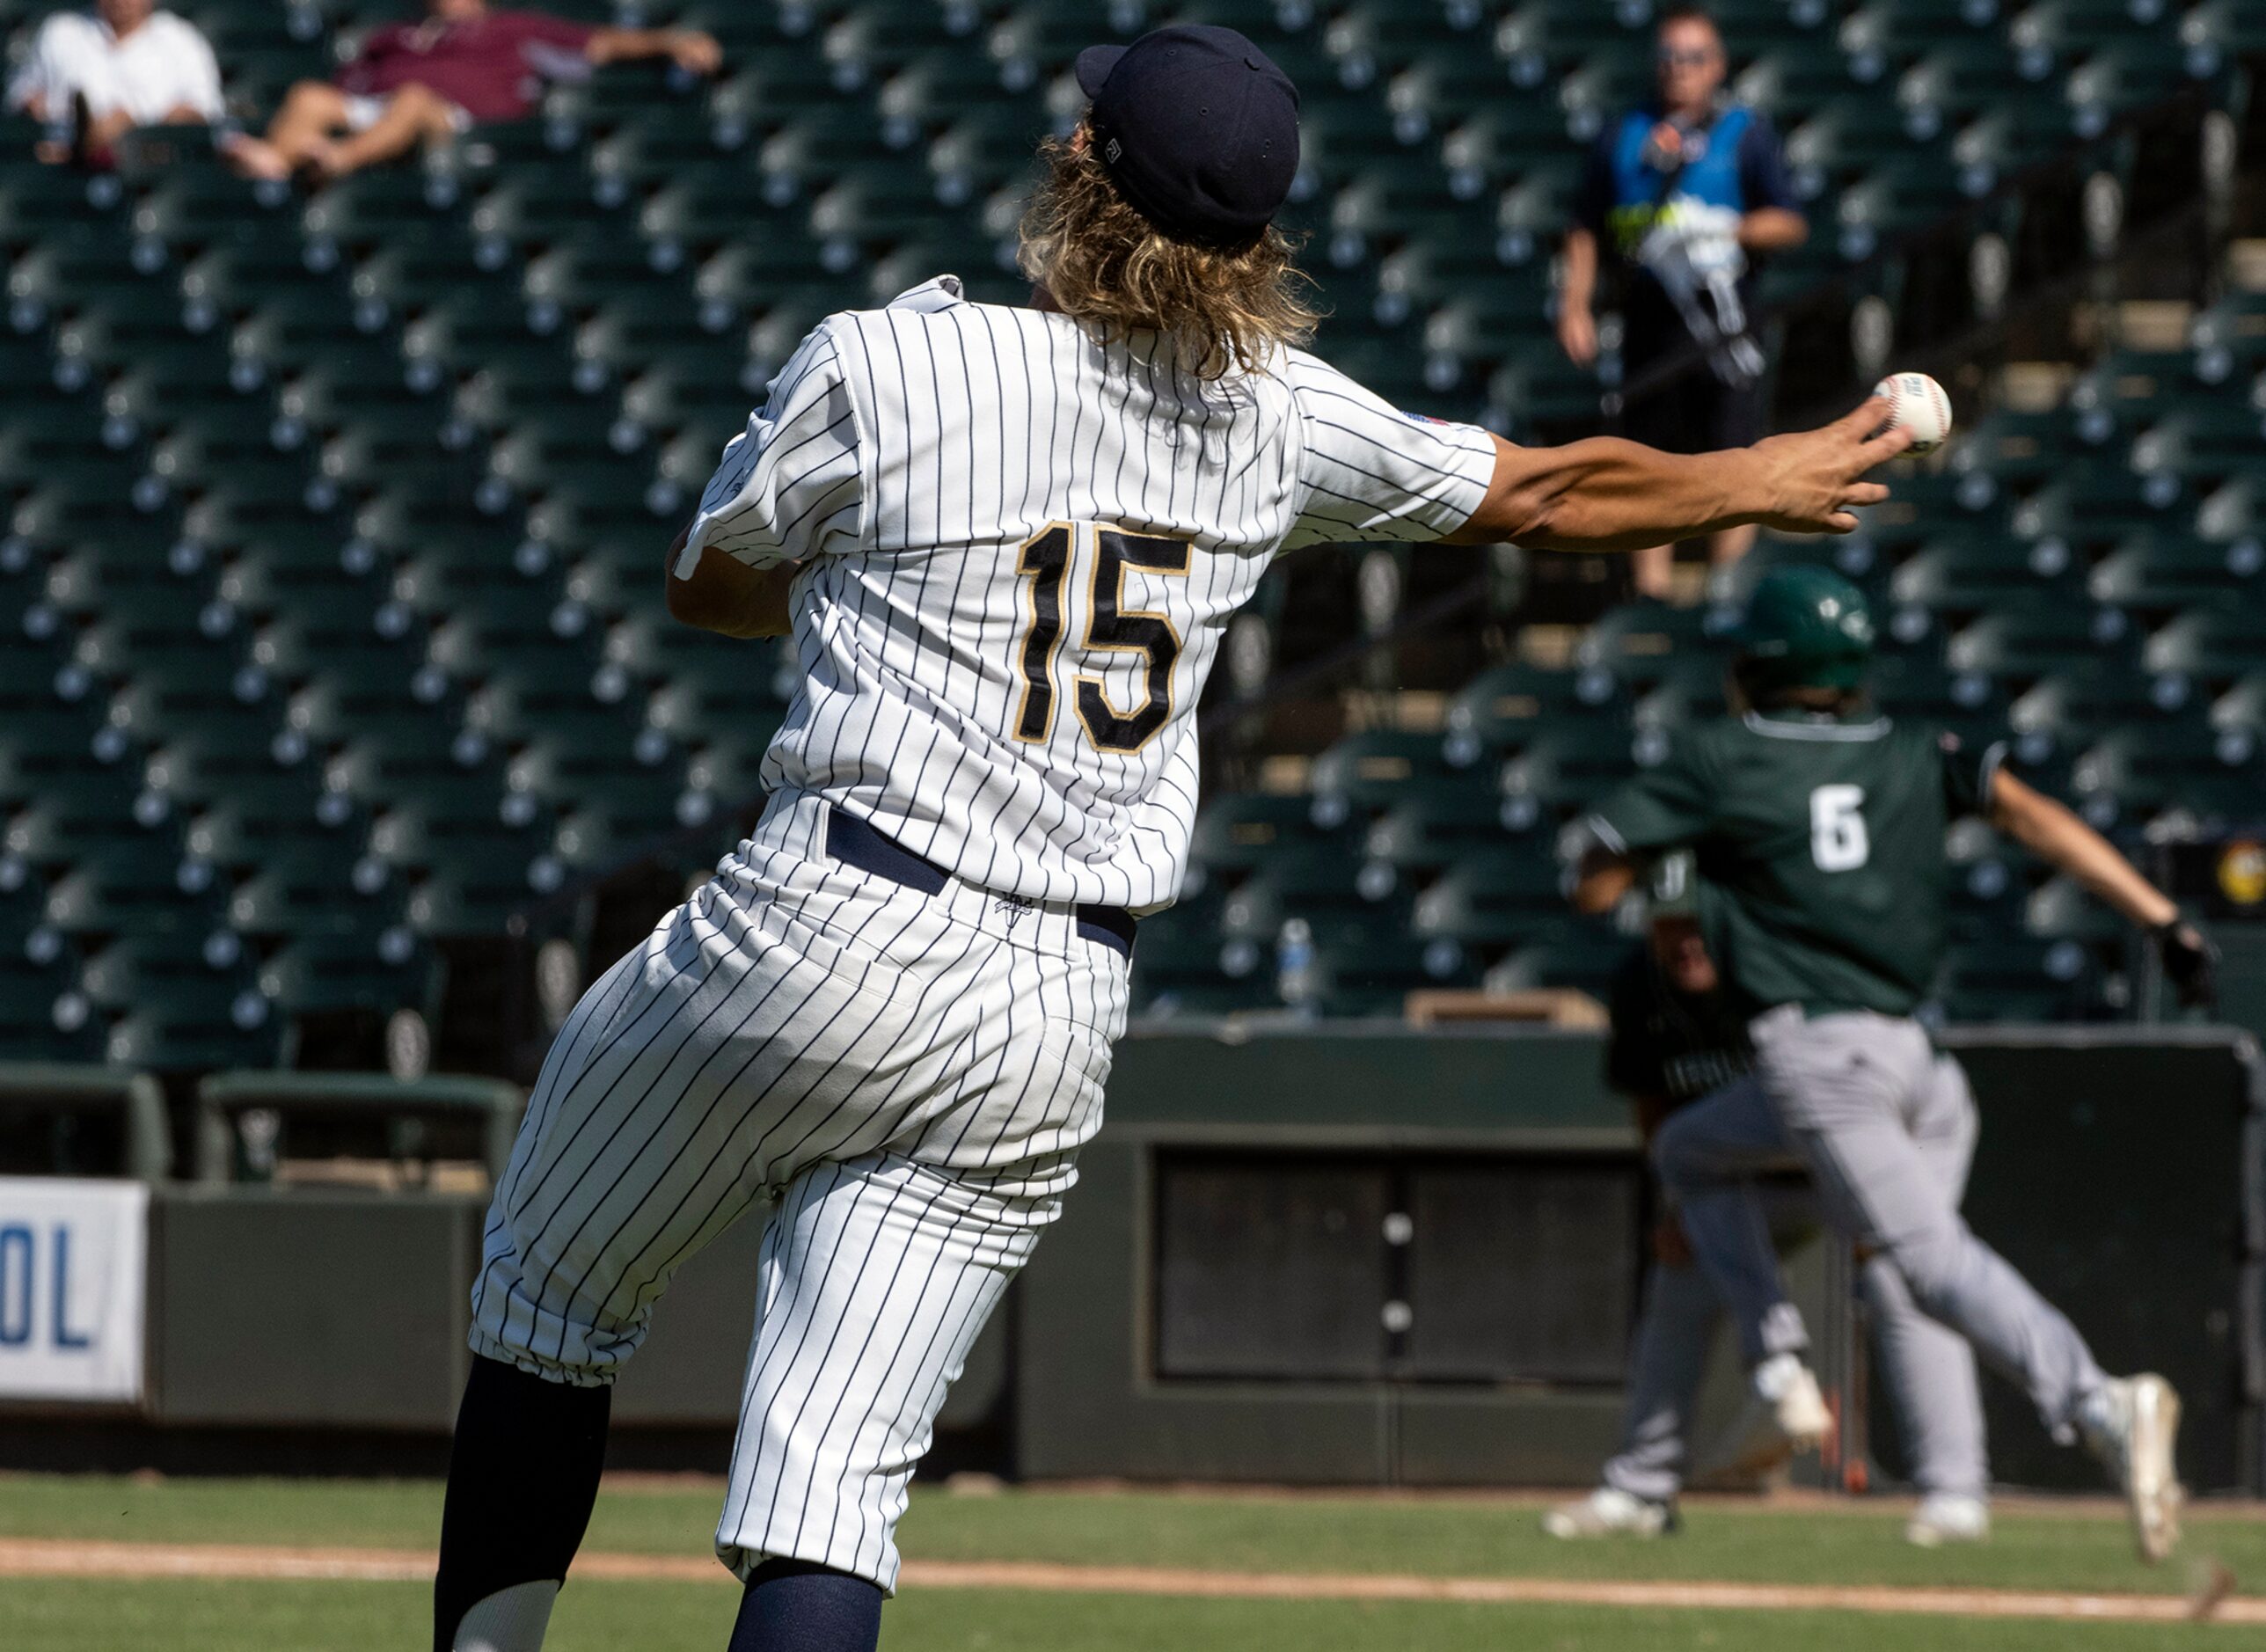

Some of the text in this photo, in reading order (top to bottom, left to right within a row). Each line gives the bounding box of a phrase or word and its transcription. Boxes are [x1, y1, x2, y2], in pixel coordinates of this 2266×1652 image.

[1013, 520, 1195, 756] 15
[1809, 783, 1870, 873] 6
[0, 1224, 98, 1349] OL
